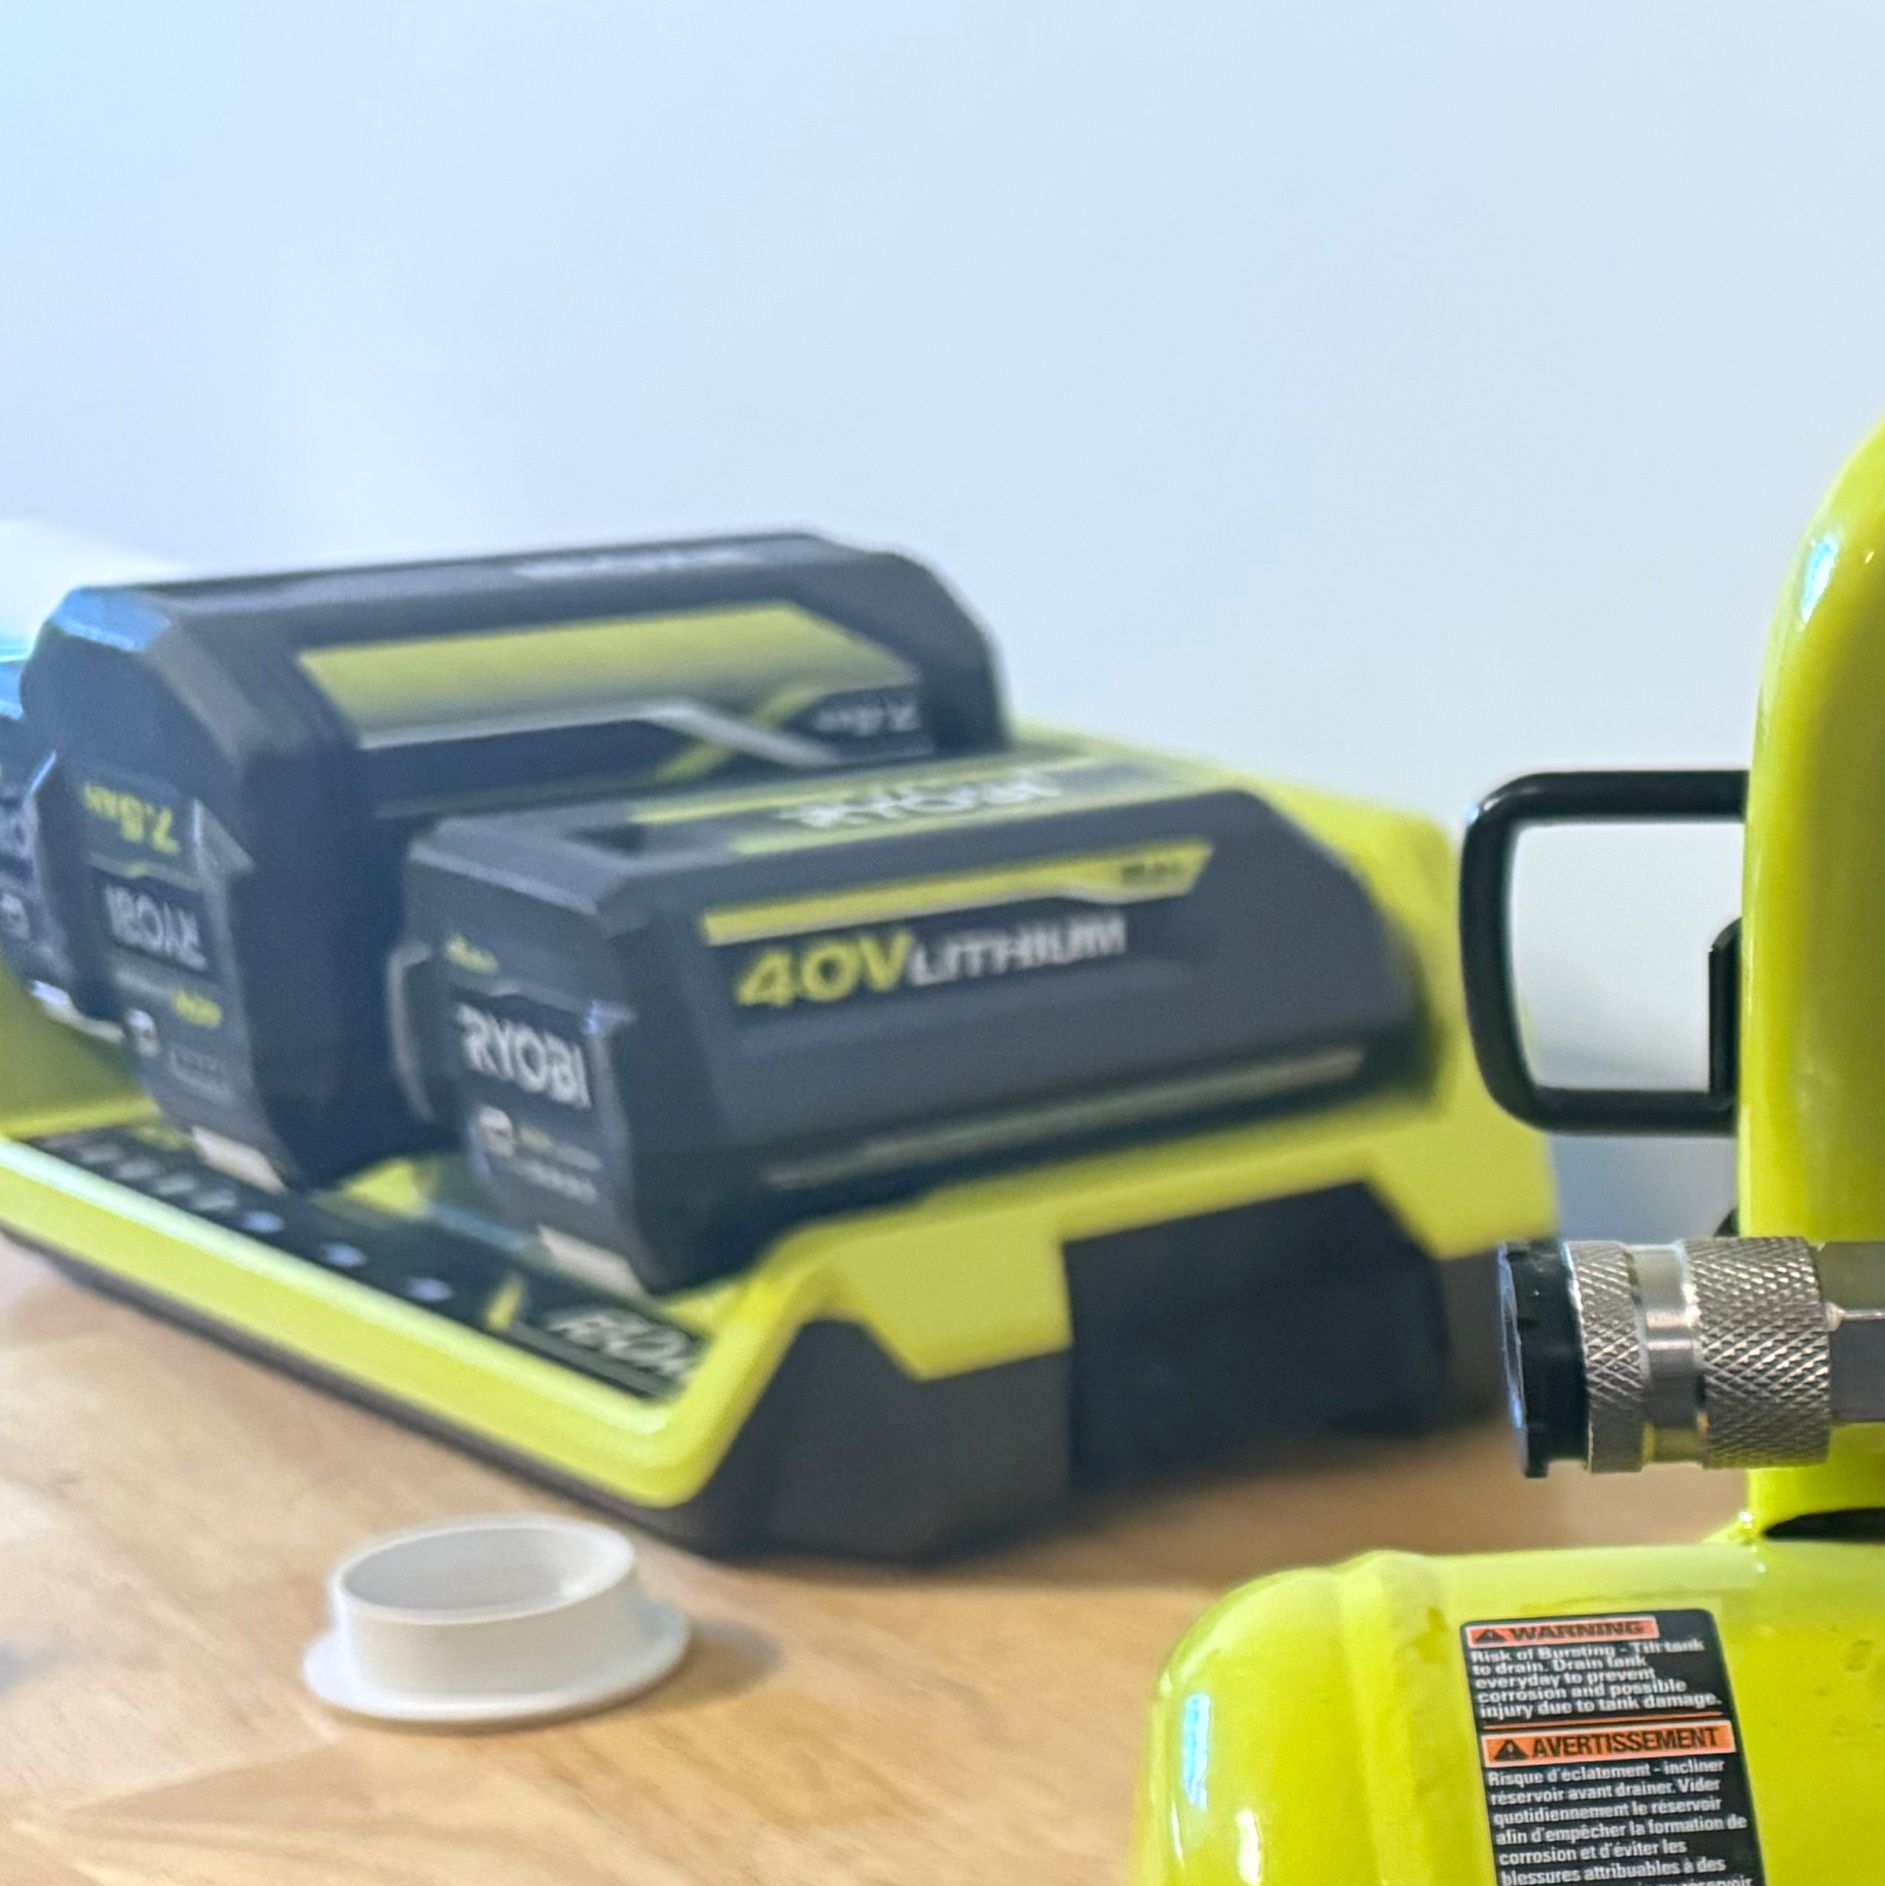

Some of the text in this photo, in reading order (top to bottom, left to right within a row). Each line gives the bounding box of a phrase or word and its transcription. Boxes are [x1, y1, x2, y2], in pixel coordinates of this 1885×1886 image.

[735, 908, 1128, 1008] 40V LITHIUM
[456, 1003, 593, 1110] RYOBI
[1511, 1622, 1644, 1641] WARNING
[1480, 1693, 1722, 1720] injury due to tank damage.
[1532, 1726, 1720, 1758] AVERTISSEMENT
